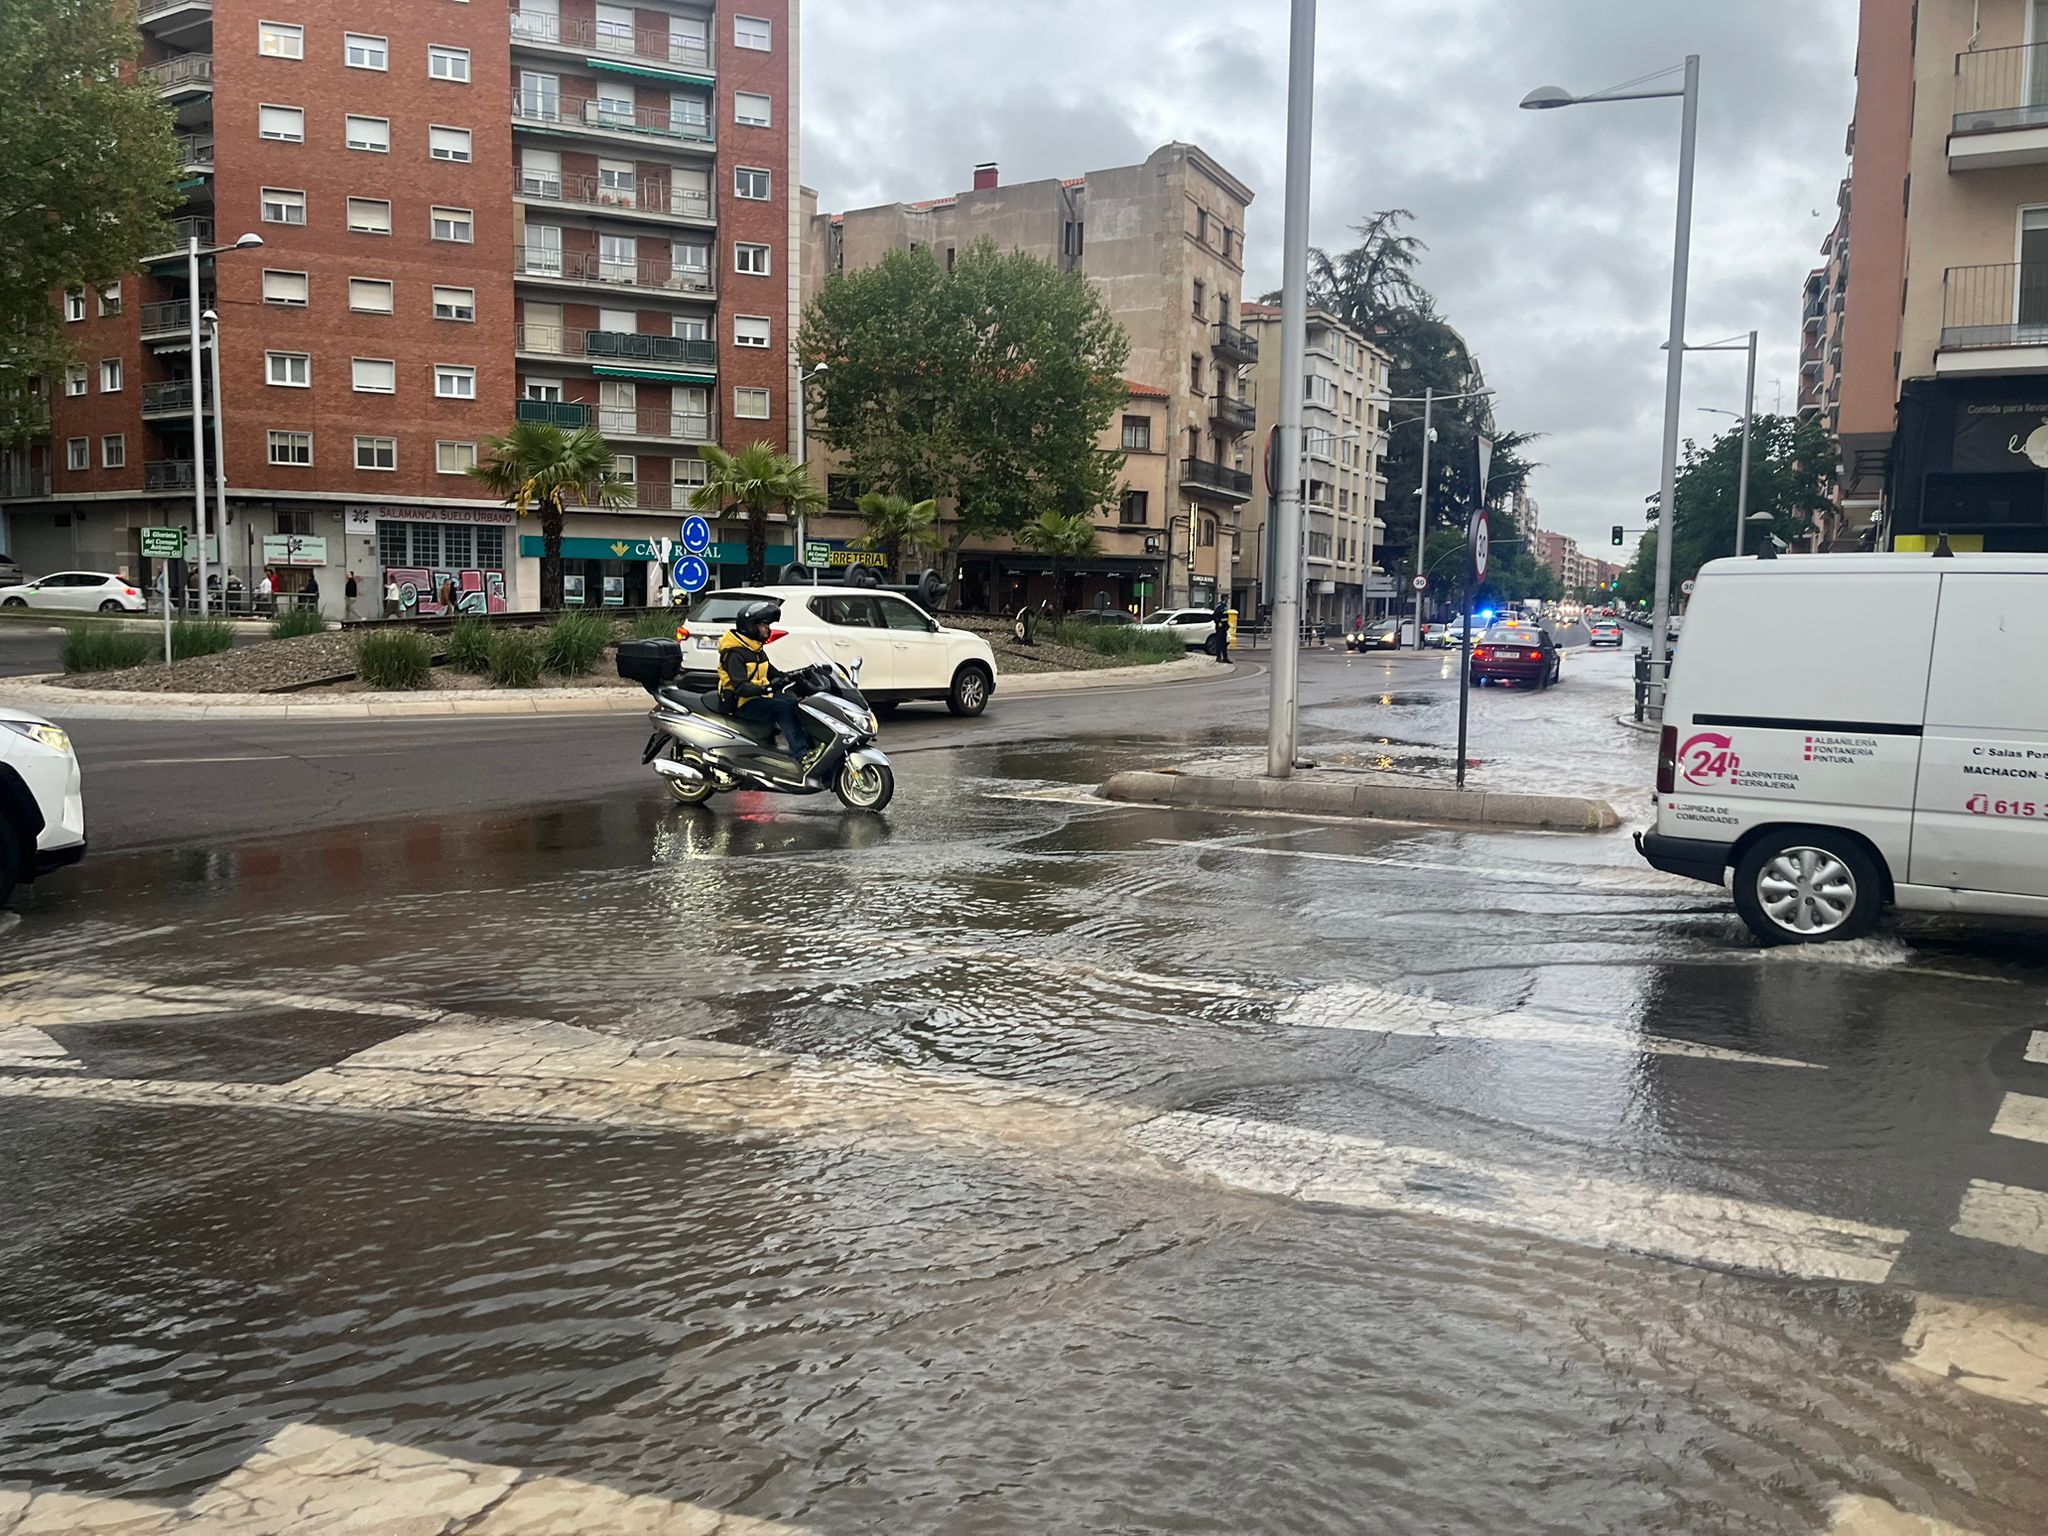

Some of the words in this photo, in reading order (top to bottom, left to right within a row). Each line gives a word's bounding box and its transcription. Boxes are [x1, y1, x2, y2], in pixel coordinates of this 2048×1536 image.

[1967, 404, 2001, 414] Comida
[2003, 405, 2023, 415] para
[380, 507, 437, 520] SALAMANCA
[440, 509, 471, 521] SUELO
[473, 510, 512, 523] URBANO
[152, 531, 177, 539] Glorieta
[635, 543, 671, 558] CA
[829, 552, 882, 565] ERRETERIA
[1683, 583, 1694, 591] 30
[1988, 748, 2022, 758] Salas
[1813, 755, 1854, 764] PINTURA
[1717, 807, 1729, 815] DE
[1994, 800, 2036, 816] 615
[1676, 813, 1740, 825] COMUNIDADES
